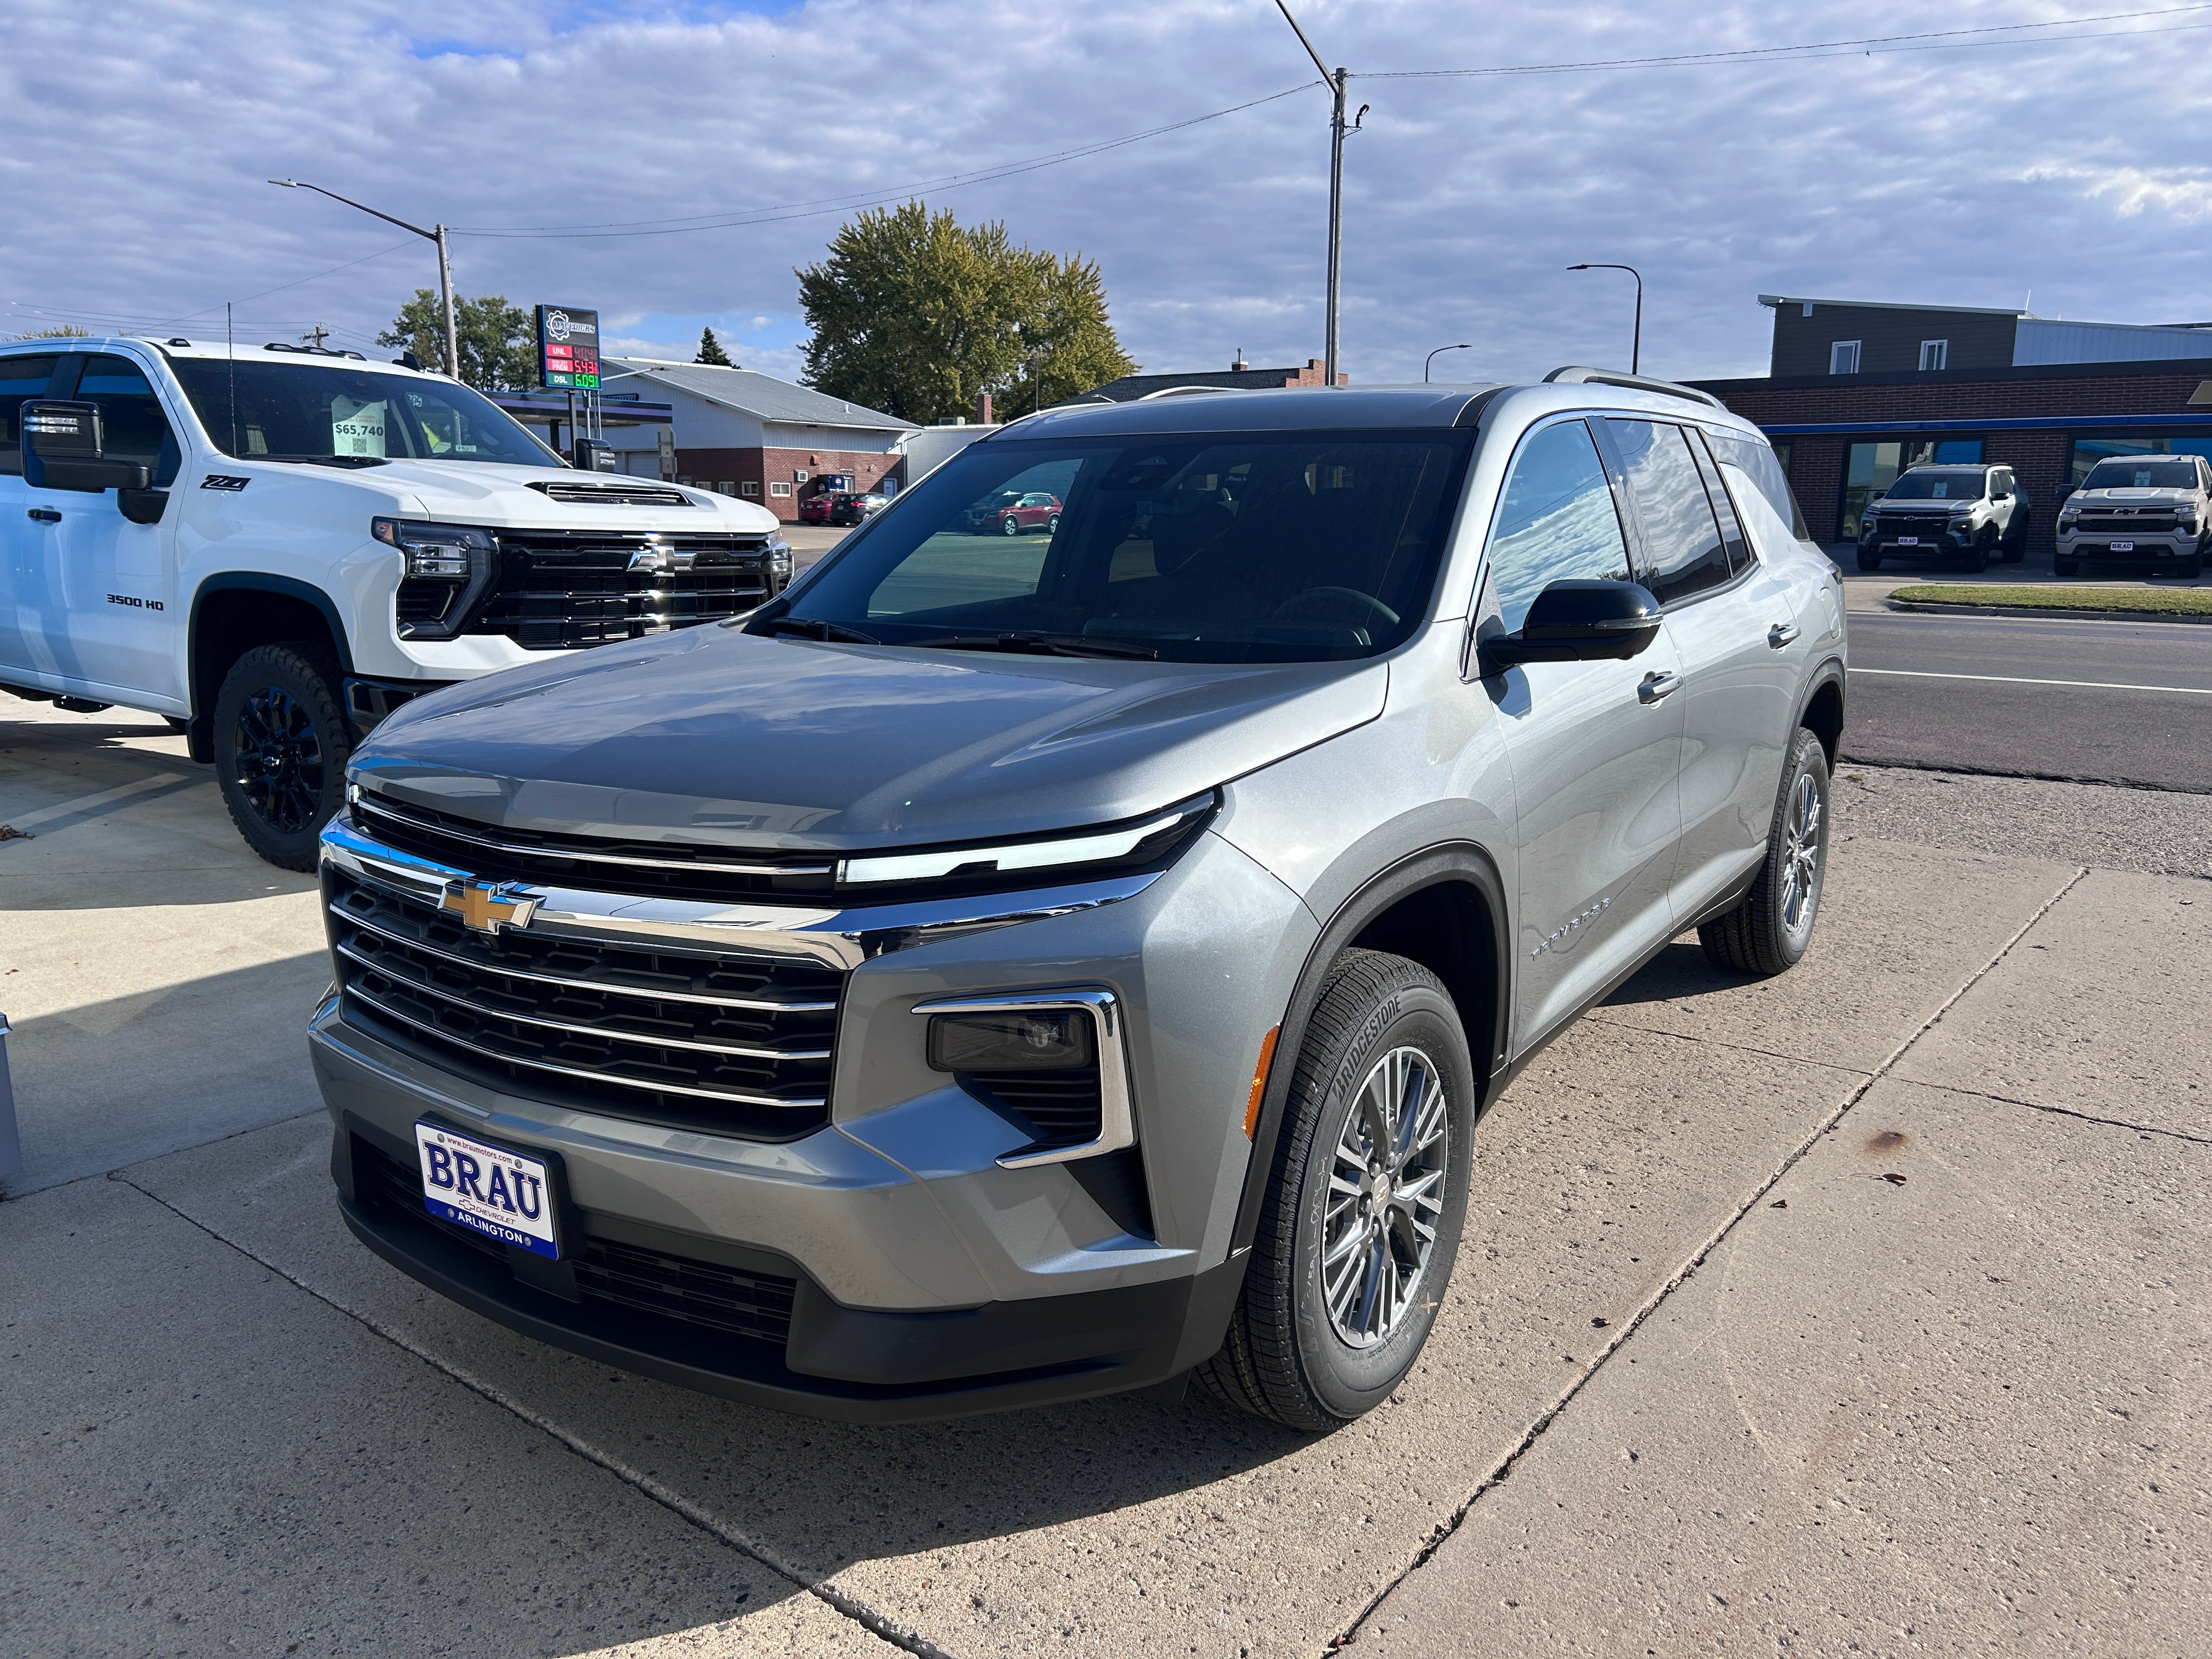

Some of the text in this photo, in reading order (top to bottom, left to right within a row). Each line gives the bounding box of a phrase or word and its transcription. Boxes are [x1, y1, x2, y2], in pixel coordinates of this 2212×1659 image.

[552, 347, 566, 355] UNL
[554, 375, 567, 383] DSL
[335, 424, 383, 437] $65,740
[106, 594, 163, 611] 3500 HD
[1531, 898, 1610, 962] TRAVERSE
[1331, 995, 1401, 1105] BRIDGESTONE
[447, 1137, 512, 1164] www.braumotors.com
[422, 1139, 541, 1222] BRAU
[476, 1207, 516, 1225] CHEVROLET
[458, 1211, 523, 1244] ARLINGTON
